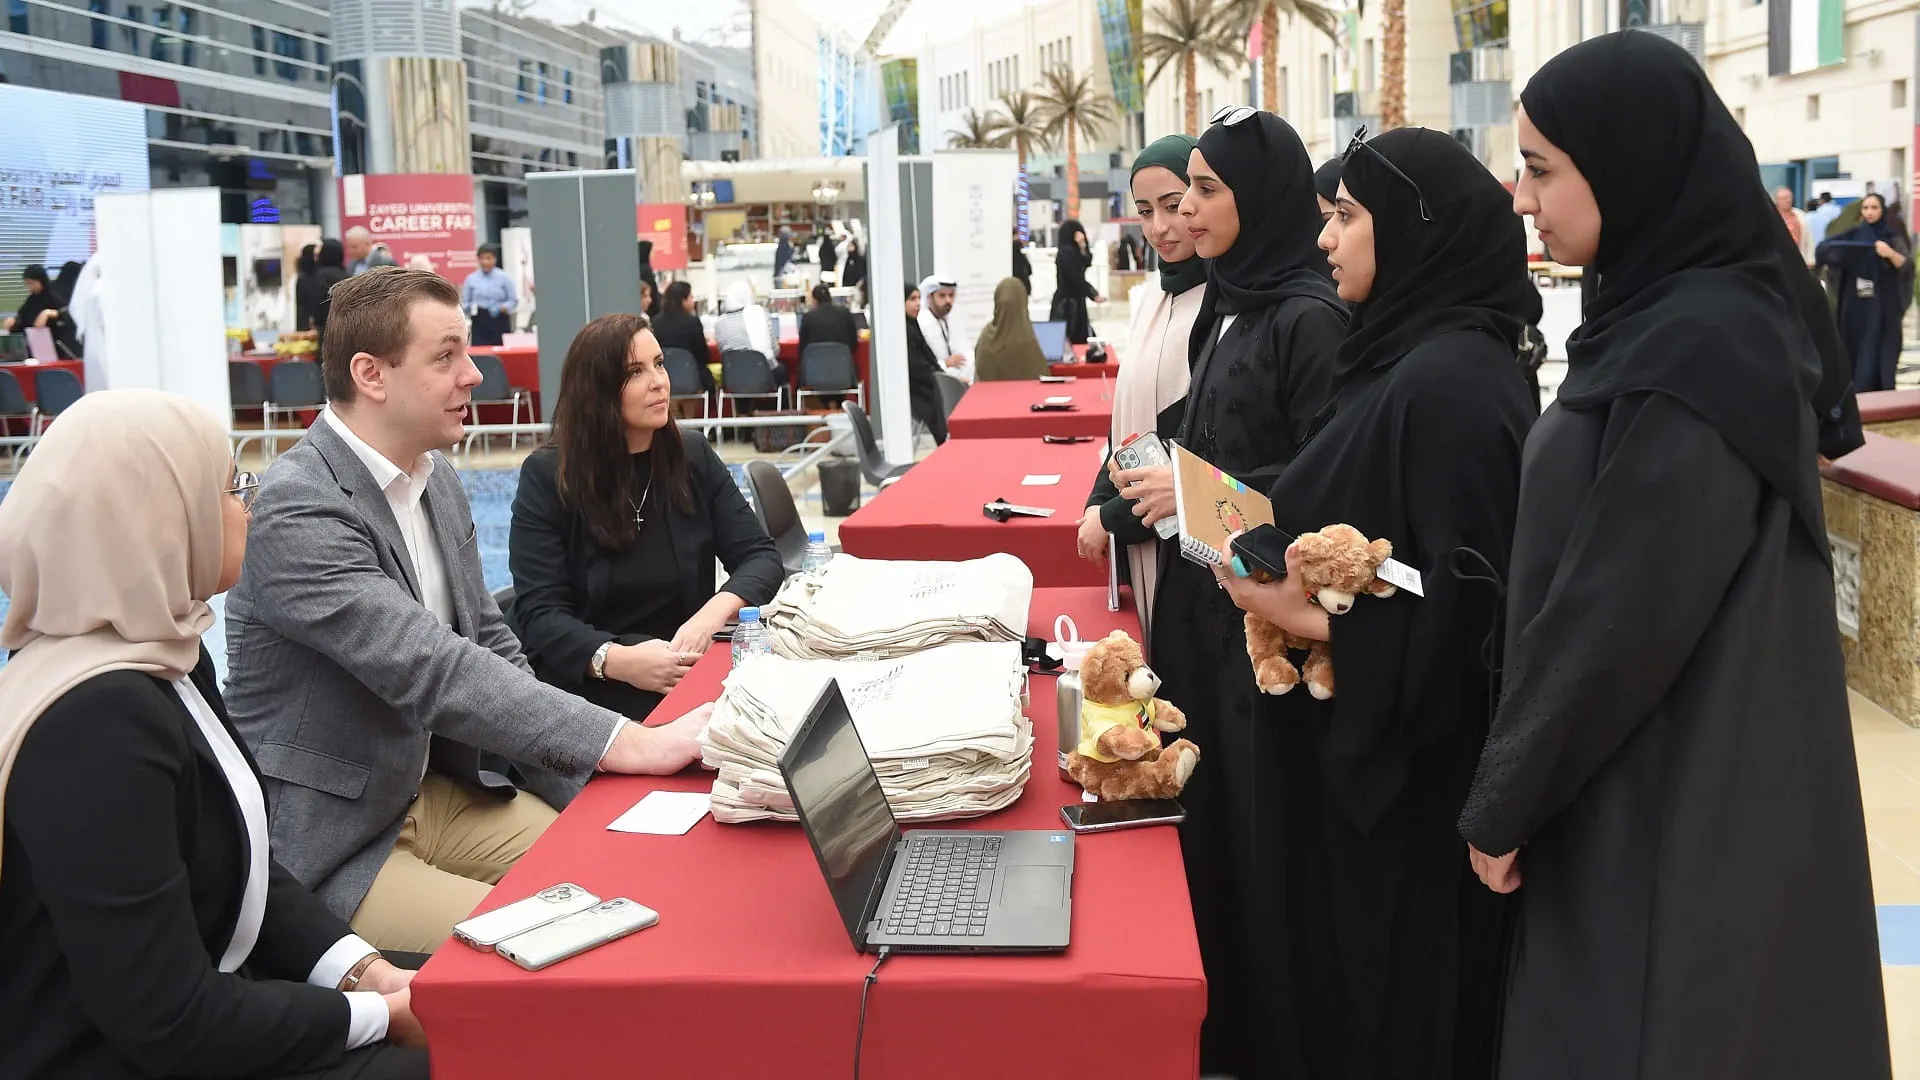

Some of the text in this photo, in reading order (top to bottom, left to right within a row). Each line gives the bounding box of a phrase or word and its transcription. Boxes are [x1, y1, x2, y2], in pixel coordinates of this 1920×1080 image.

[368, 203, 407, 215] ZAYED
[369, 214, 473, 232] CAREER FAIR
